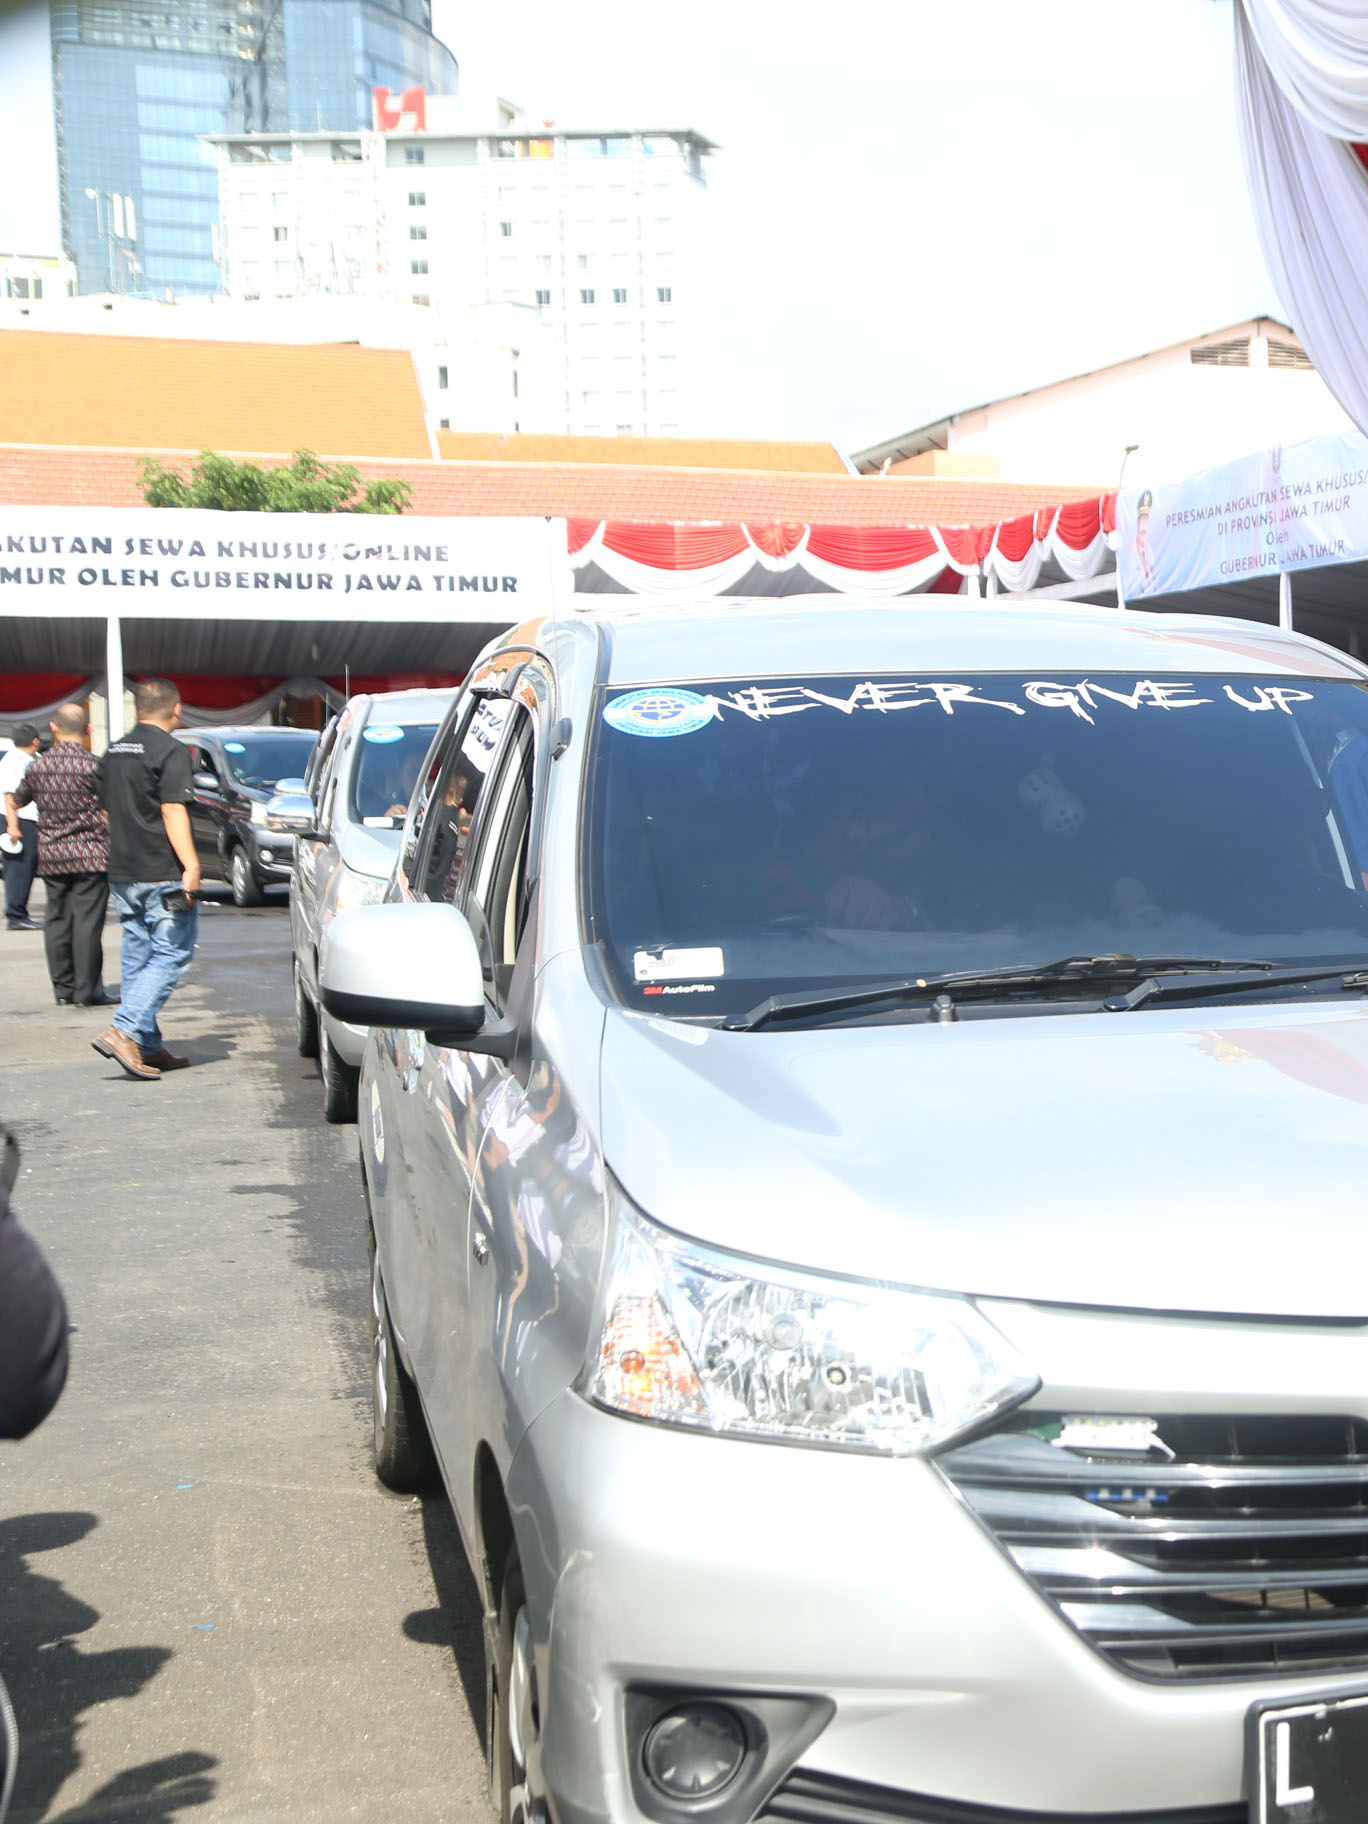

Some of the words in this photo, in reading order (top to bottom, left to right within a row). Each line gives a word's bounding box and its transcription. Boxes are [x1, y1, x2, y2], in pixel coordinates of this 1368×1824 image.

[1166, 504, 1222, 528] PERESMIAN
[1225, 489, 1277, 514] ANGKUTAN
[1280, 482, 1312, 501] SEWA
[1218, 521, 1228, 536] DI
[1231, 510, 1277, 534] PROVINSI
[1280, 504, 1308, 523] JAWA
[1312, 495, 1351, 516] TIMUR
[0, 536, 112, 554] KUTAN
[125, 538, 206, 557] SEWA
[1266, 529, 1289, 545] Oleh
[1220, 552, 1277, 575] GUBERNUR
[1309, 540, 1345, 559] TIMUR
[78, 568, 159, 586] OLEH
[171, 570, 333, 589] GUBERNUR
[345, 574, 423, 594] JAWA
[433, 575, 518, 593] TIMUR
[704, 681, 1026, 721] NEVER
[1022, 679, 1214, 725] GIVE
[1223, 685, 1314, 715] UP
[1276, 1722, 1314, 1807] L
